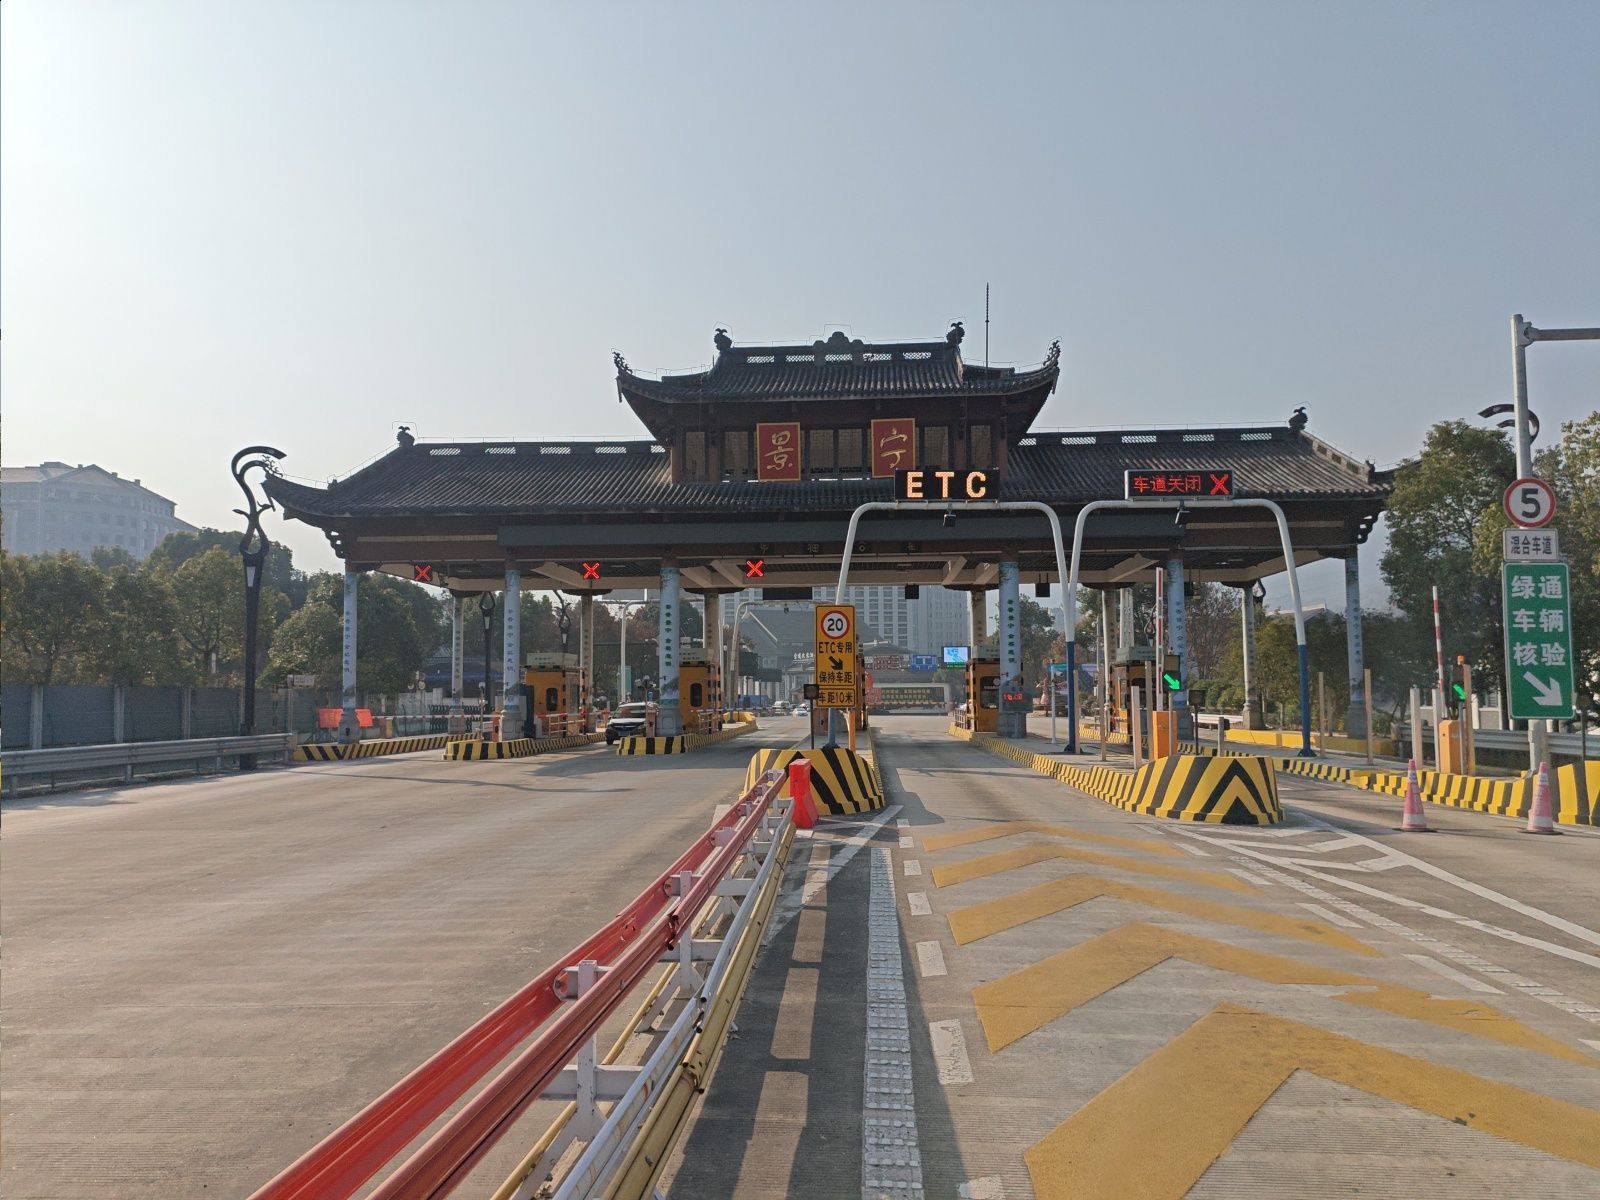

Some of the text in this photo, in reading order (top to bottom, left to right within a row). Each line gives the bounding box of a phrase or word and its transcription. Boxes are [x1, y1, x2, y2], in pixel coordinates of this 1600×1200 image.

[907, 471, 986, 498] ETC
[1133, 475, 1201, 493] 车道关闭
[1520, 488, 1541, 519] 5
[1510, 535, 1553, 555] 混合车道
[1511, 575, 1563, 600] 绿通
[826, 618, 844, 632] 20
[1512, 608, 1564, 633] 车辆
[818, 642, 853, 654] ETC专用
[1513, 642, 1566, 667] 核验
[819, 671, 853, 684] 保持车距
[818, 691, 853, 704] 车距10米
